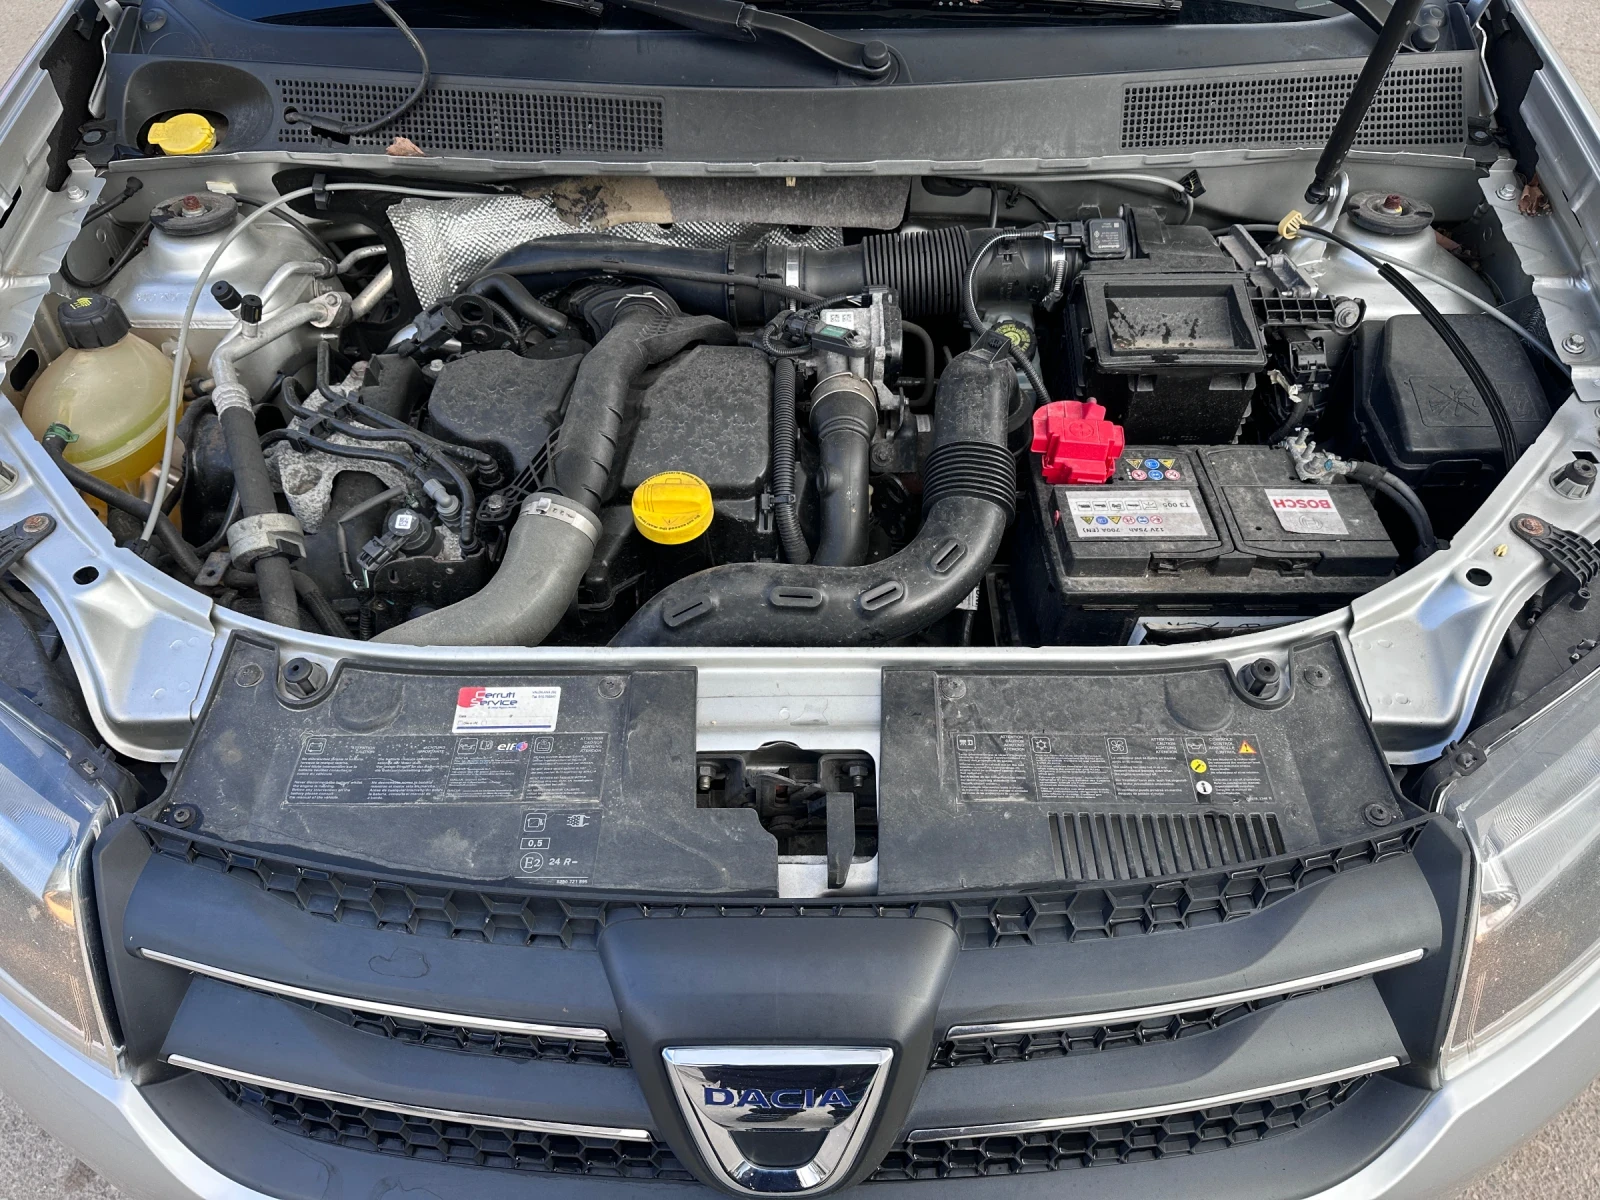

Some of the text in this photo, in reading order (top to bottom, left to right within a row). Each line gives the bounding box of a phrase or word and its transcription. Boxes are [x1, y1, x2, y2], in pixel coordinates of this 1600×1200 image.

[1272, 499, 1331, 509] BOSCH
[470, 698, 518, 706] Service
[528, 840, 543, 848] 0,5
[524, 857, 540, 869] E2
[703, 1087, 852, 1109] DACIA
